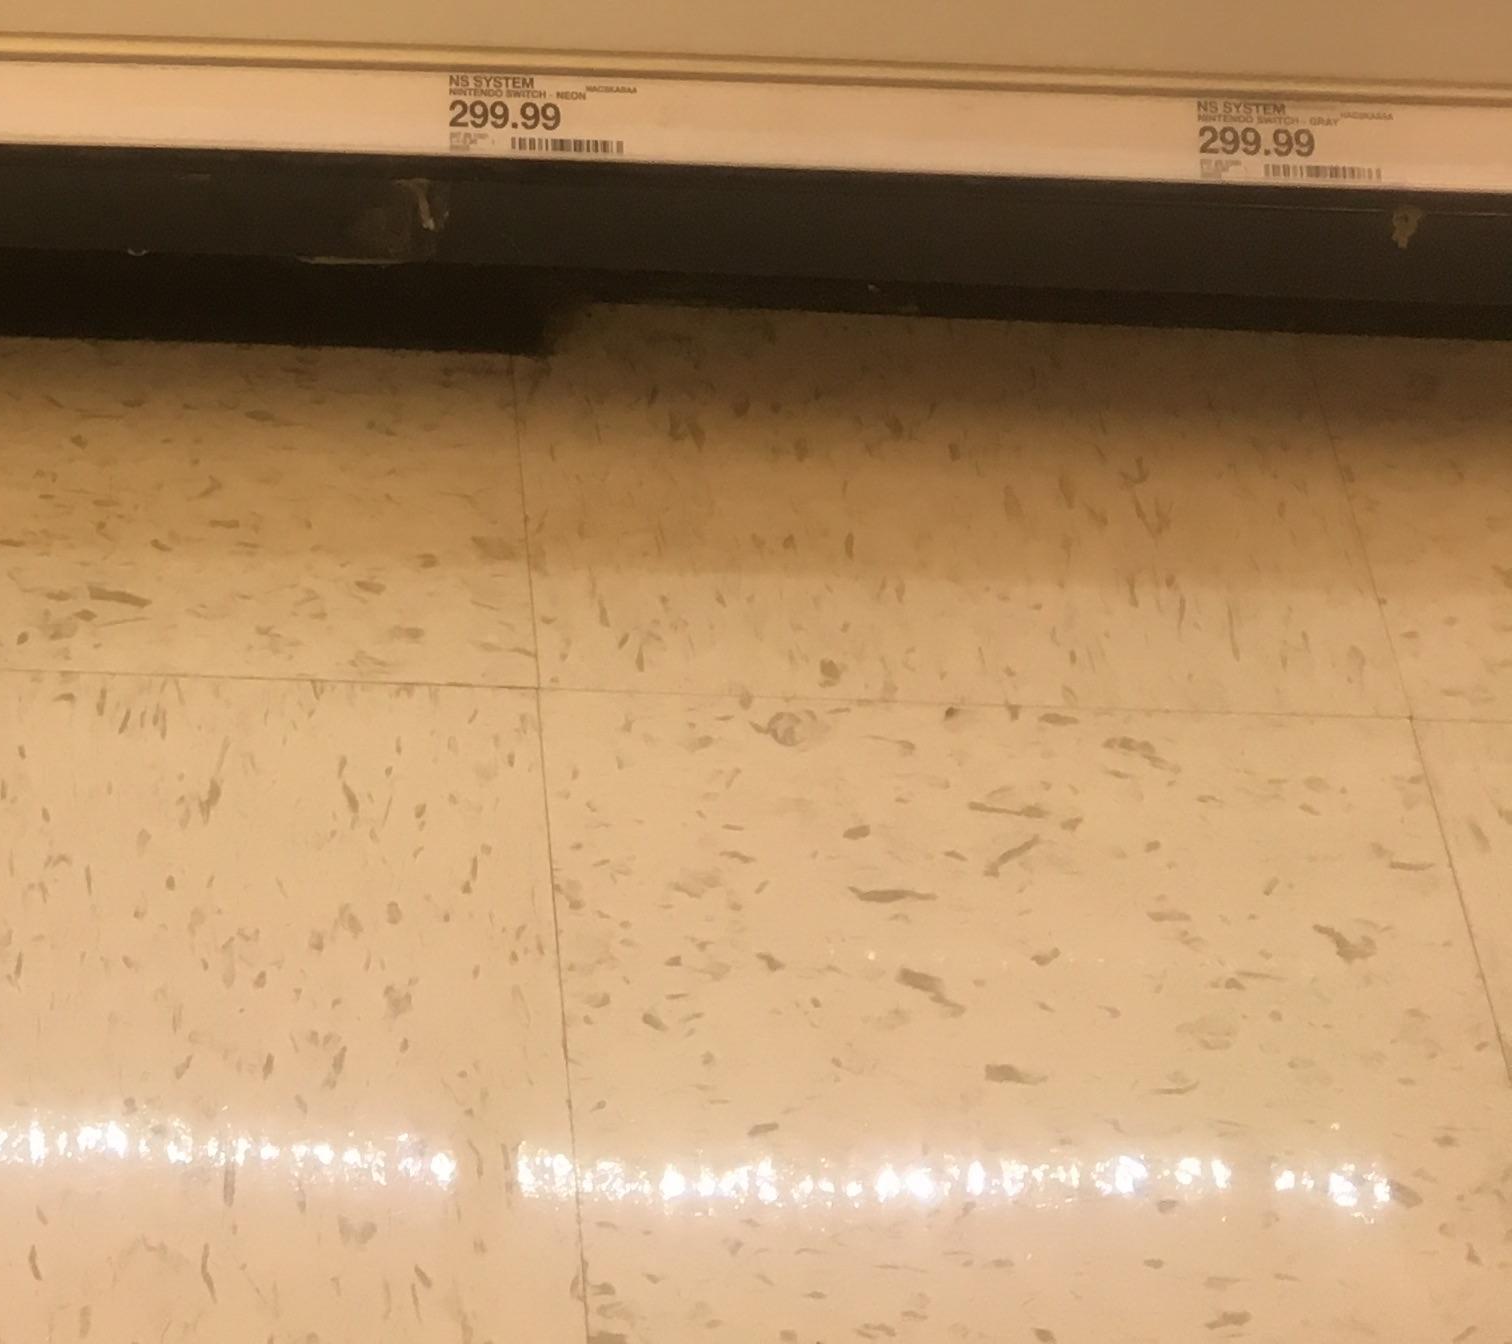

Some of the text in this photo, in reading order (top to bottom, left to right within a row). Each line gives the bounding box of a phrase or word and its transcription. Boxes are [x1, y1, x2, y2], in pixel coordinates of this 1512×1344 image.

[449, 75, 535, 89] NS SYSTEM
[449, 88, 504, 98] NINTENDO
[506, 89, 547, 99] SWITCH
[556, 91, 587, 101] NEON
[449, 99, 561, 131] 299.99
[1197, 100, 1287, 116] NS SYSTEM
[1197, 113, 1254, 124] NINTENDO
[1256, 116, 1300, 126] SWITCH
[1309, 117, 1339, 127] GRAY
[1198, 125, 1315, 158] 299.99
